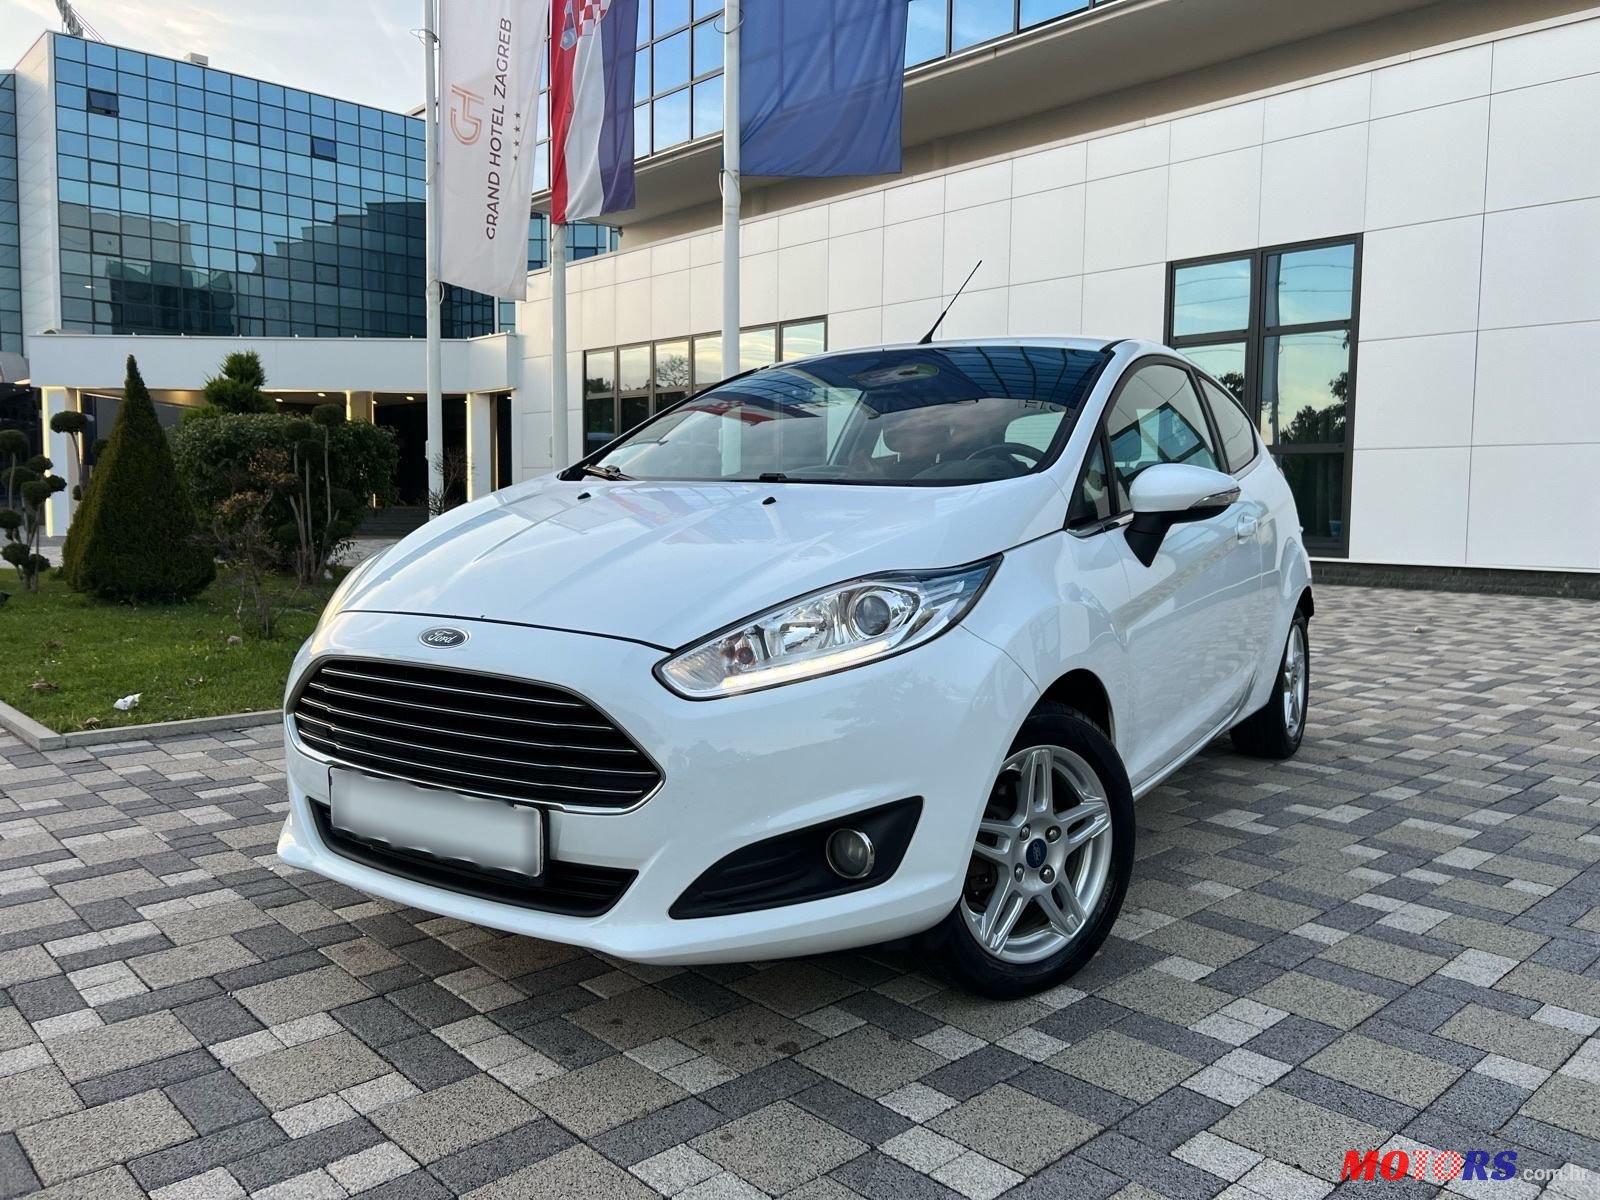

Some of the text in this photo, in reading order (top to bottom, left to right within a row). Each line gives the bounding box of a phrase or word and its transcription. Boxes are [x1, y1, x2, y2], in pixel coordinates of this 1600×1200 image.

[486, 17, 512, 240] GRAND HOTEL ZAGREB
[427, 630, 457, 643] Ford
